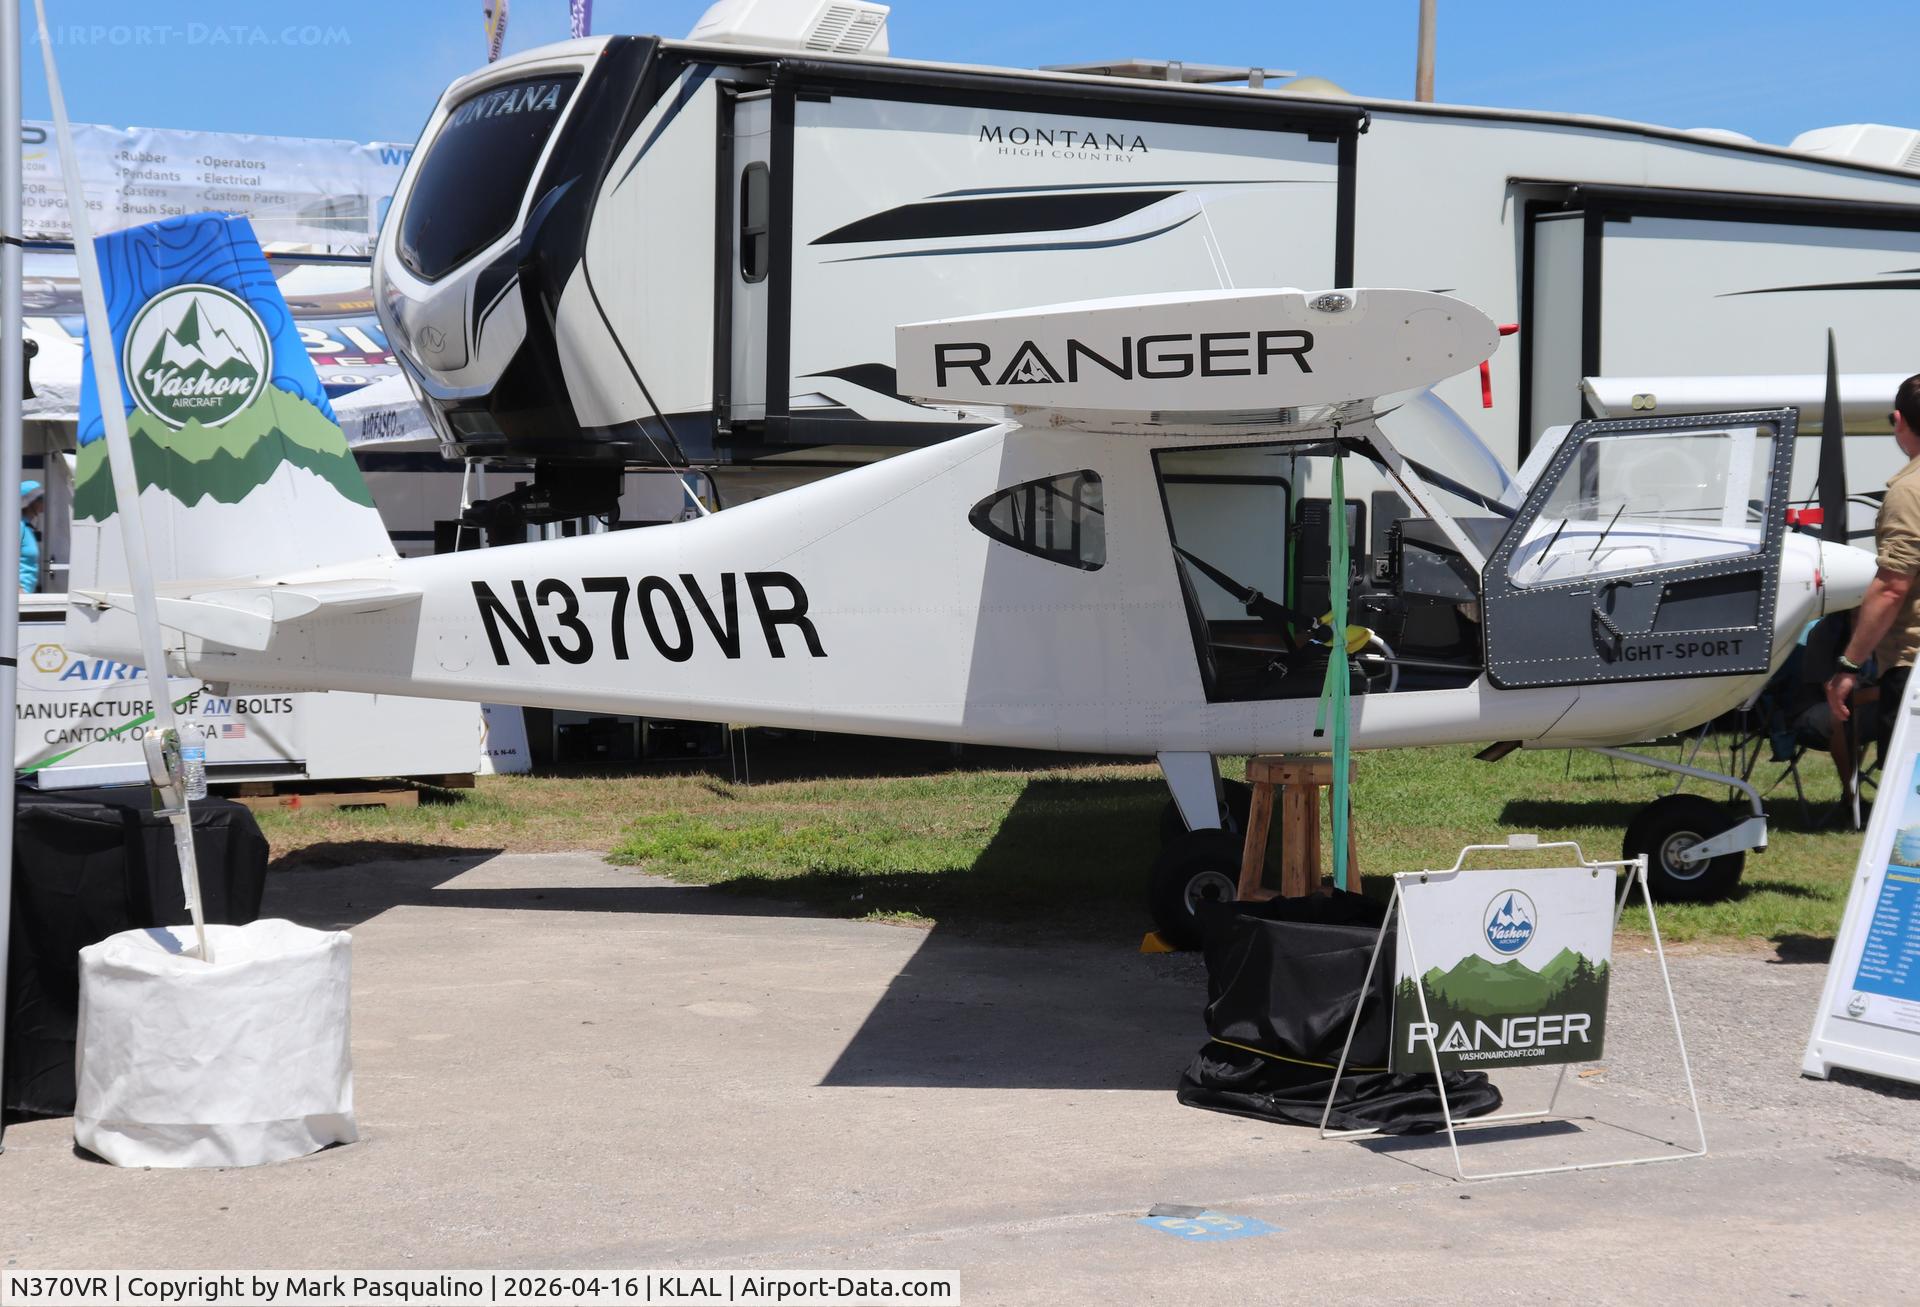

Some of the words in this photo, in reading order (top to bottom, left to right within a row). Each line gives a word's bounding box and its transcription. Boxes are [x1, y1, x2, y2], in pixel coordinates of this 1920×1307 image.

[978, 125, 1149, 153] MONTANA
[121, 151, 167, 164] Rubber
[998, 147, 1044, 158] HIGH
[1052, 151, 1134, 163] COUNTRY
[203, 156, 266, 170] Operators
[122, 168, 181, 181] Pendants
[204, 173, 261, 186] Electrical
[122, 184, 167, 198] Casters
[204, 190, 250, 202] Custom
[253, 192, 285, 205] Parts
[123, 202, 157, 215] Brush
[160, 203, 187, 215] Seal
[933, 329, 1315, 388] RANGER
[144, 368, 251, 397] Vashon
[172, 397, 223, 408] AIRCRAFT
[471, 571, 828, 666] N370VR
[202, 699, 232, 717] AN
[236, 698, 293, 715] BOLTS
[44, 727, 126, 745] CANTON,
[1407, 1013, 1592, 1054] RANGER
[1458, 1048, 1546, 1061] VASHONAIRCRAFT.COM
